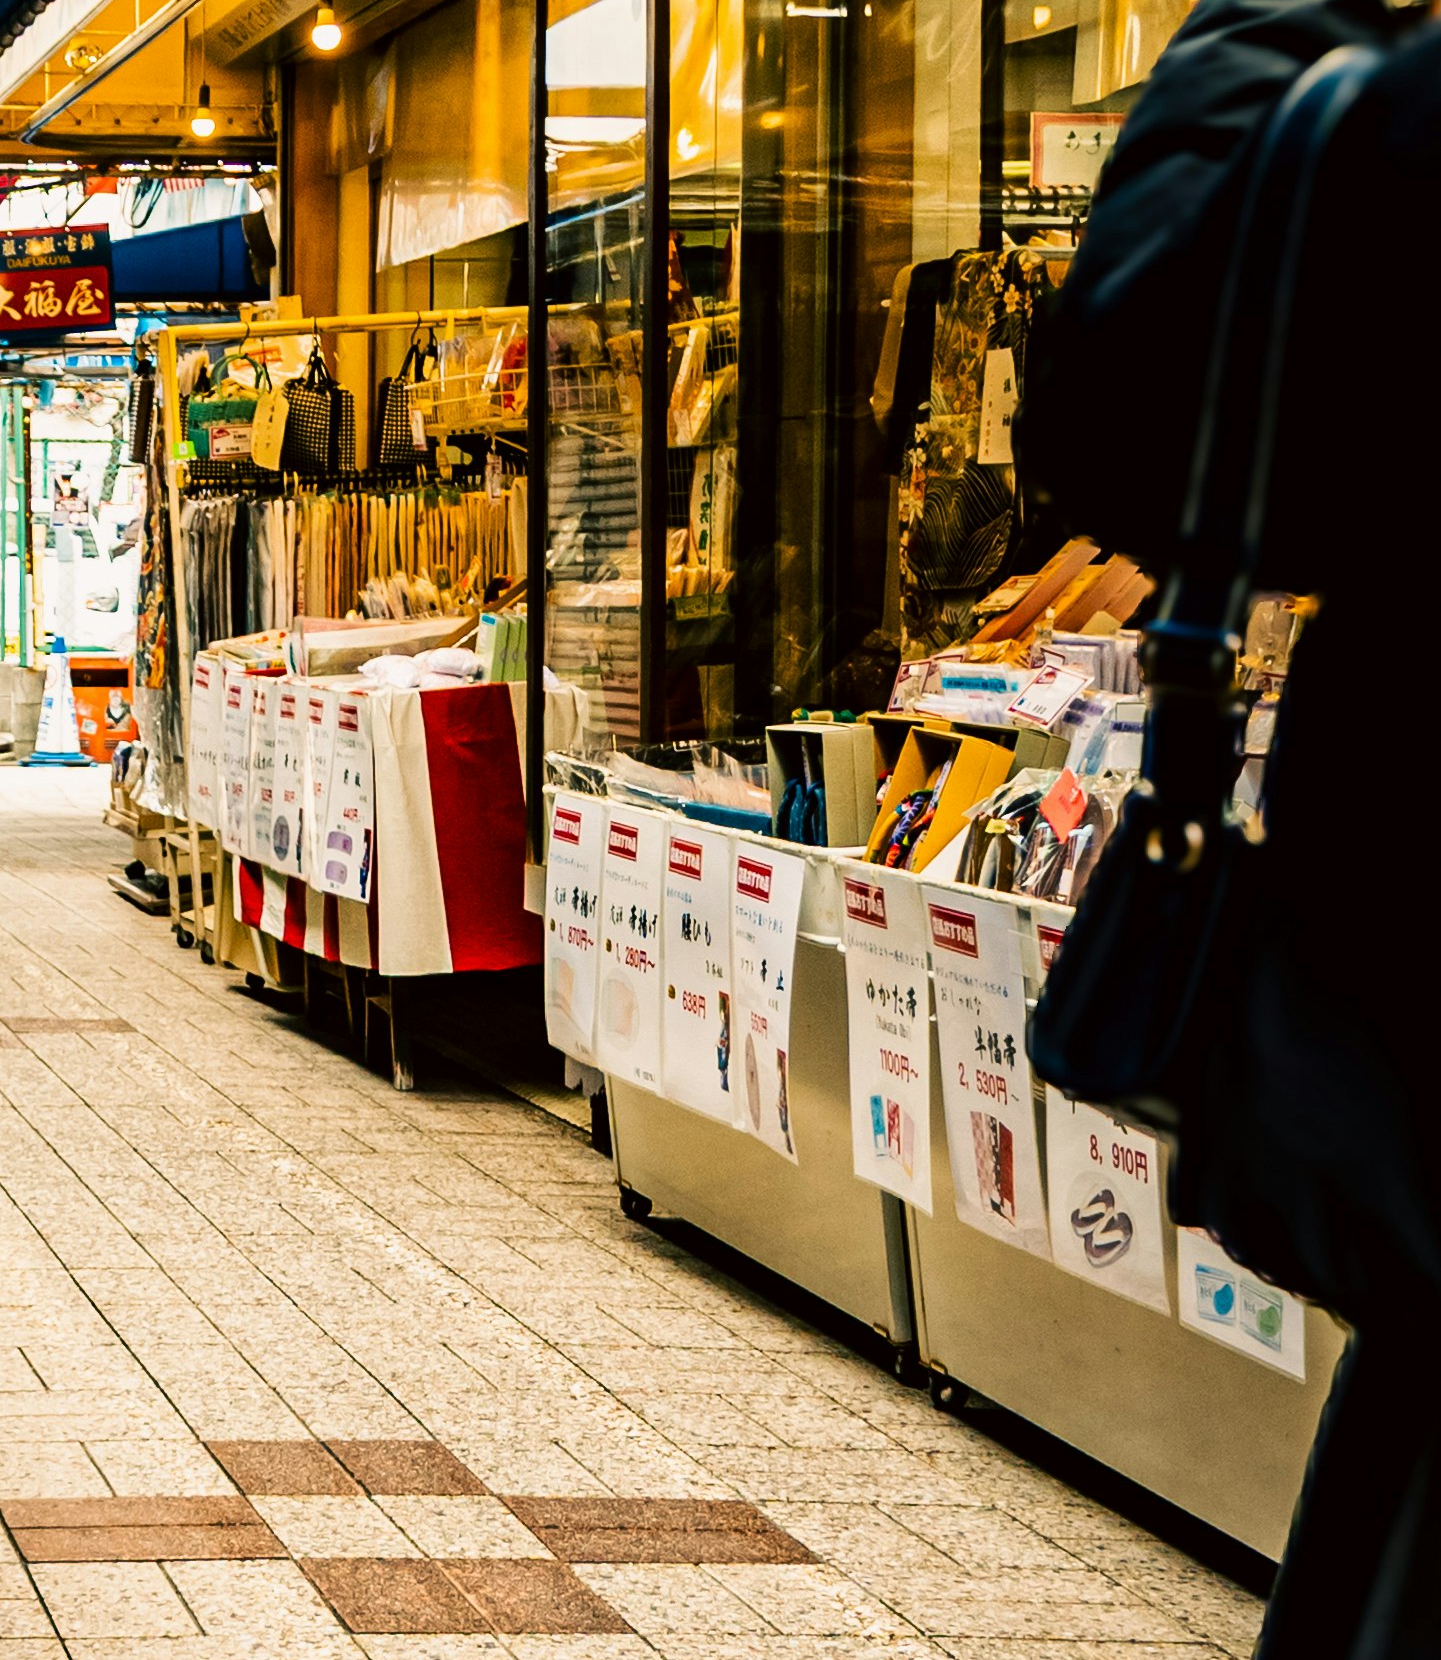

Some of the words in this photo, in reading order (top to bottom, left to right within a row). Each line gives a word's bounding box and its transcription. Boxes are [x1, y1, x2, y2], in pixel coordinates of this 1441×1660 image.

[6, 255, 71, 268] DAIFUKUYA
[682, 989, 706, 1020] 638円
[865, 977, 917, 1023] ゆかた帯
[940, 986, 981, 1017] おしゃれな
[974, 1024, 1017, 1072] 半幅帯
[1089, 1134, 1148, 1184] 8,910円
